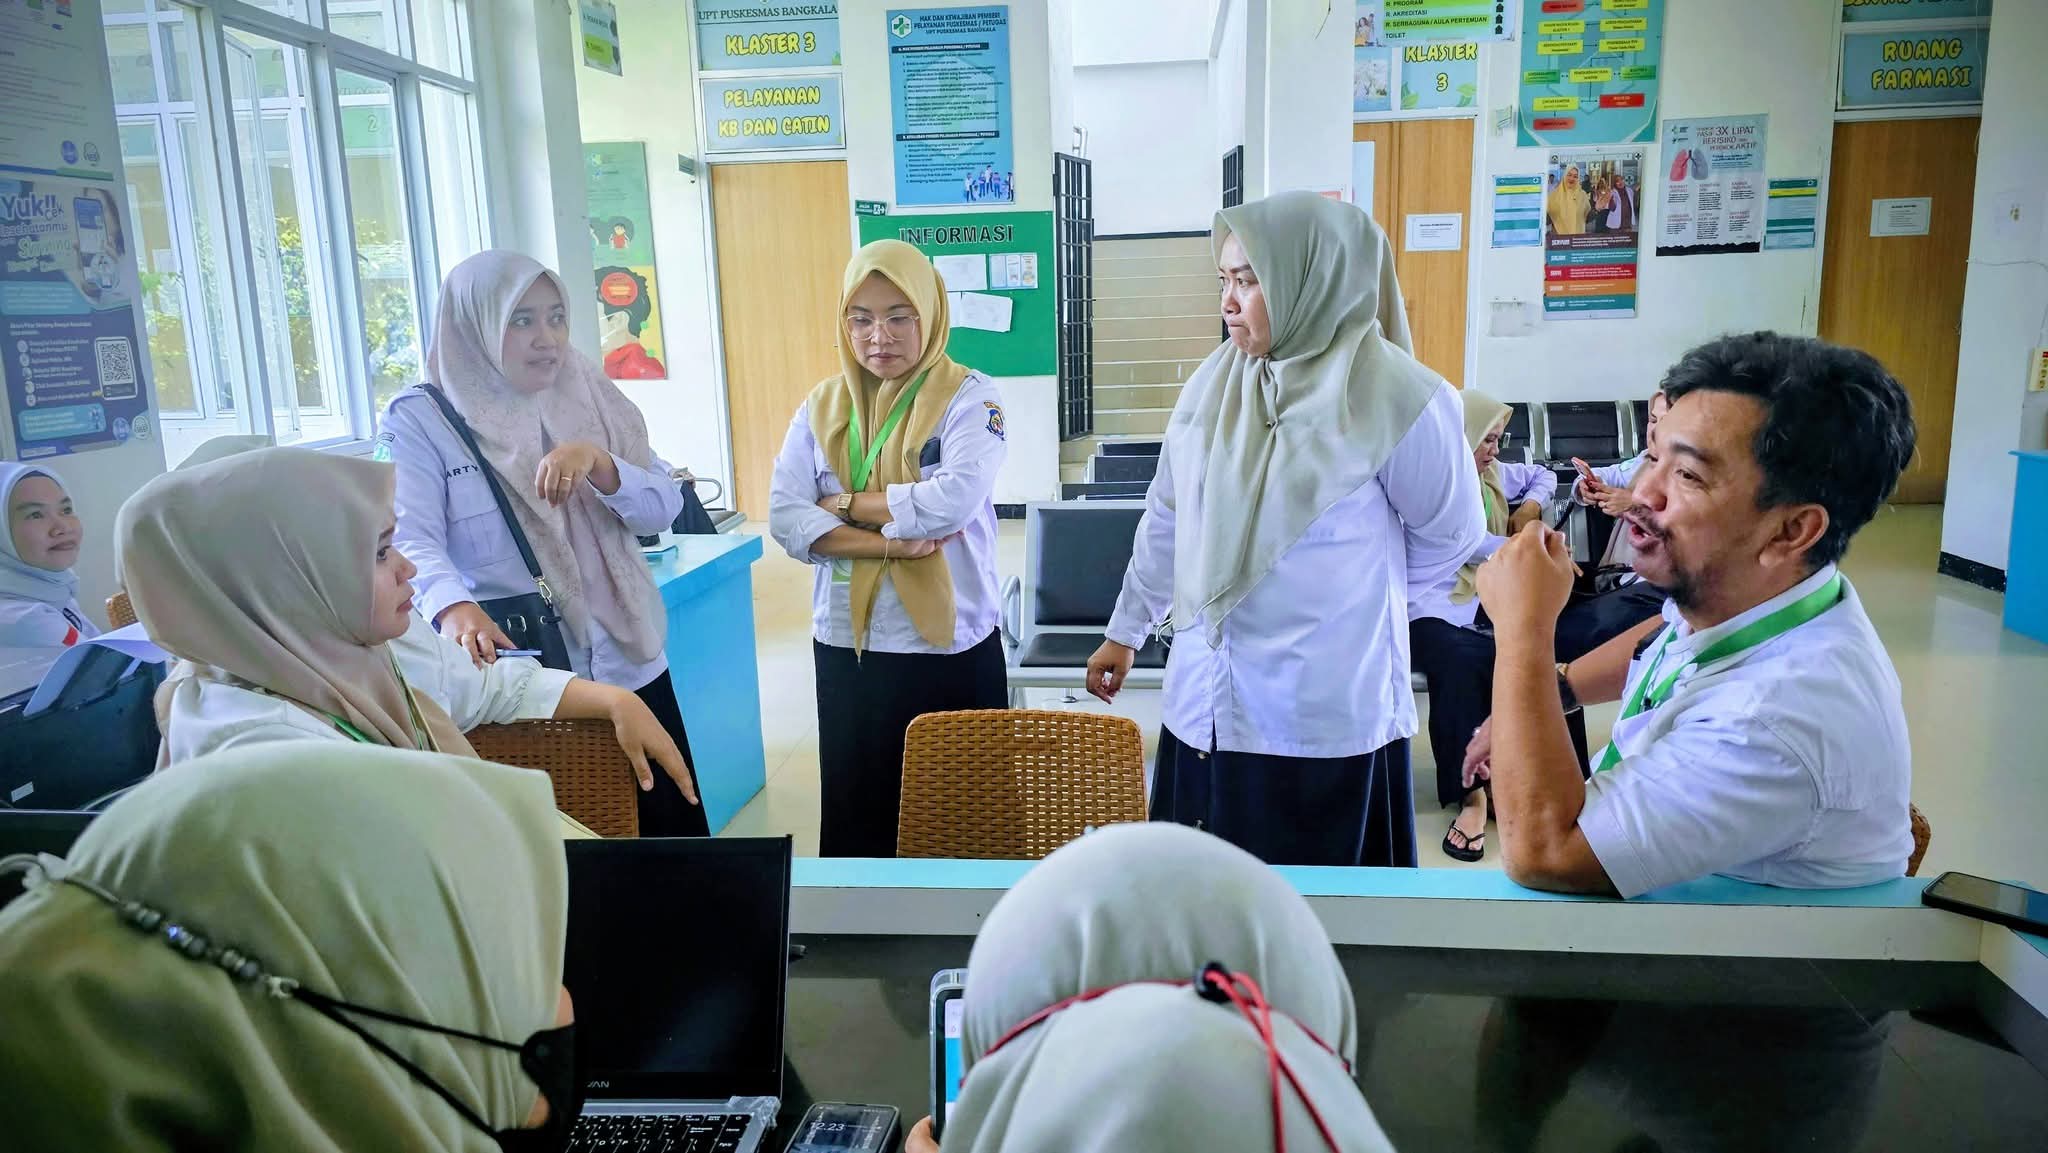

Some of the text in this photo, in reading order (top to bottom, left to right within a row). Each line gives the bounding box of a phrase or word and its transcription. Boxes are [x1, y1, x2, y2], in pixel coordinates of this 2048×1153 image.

[699, 5, 838, 21] UPT PUSKESMAS BANGKALA
[1393, 19, 1430, 27] SERBAGUNA
[1451, 16, 1488, 24] PERTEMUAN
[914, 21, 945, 29] PELAYANAN
[946, 20, 977, 28] PUSKESMAS
[725, 31, 816, 56] KLASTER 3
[1404, 42, 1478, 63] KLASTER
[1883, 37, 1963, 62] RUANG
[1436, 72, 1449, 92] 3
[1871, 66, 1973, 90] FARMASI
[723, 85, 821, 108] PELAYANAN
[718, 114, 830, 138] KB DAN CATIN
[1715, 126, 1729, 136] 3X
[1732, 125, 1755, 135] LIPAT
[898, 224, 1014, 246] INFORMASI
